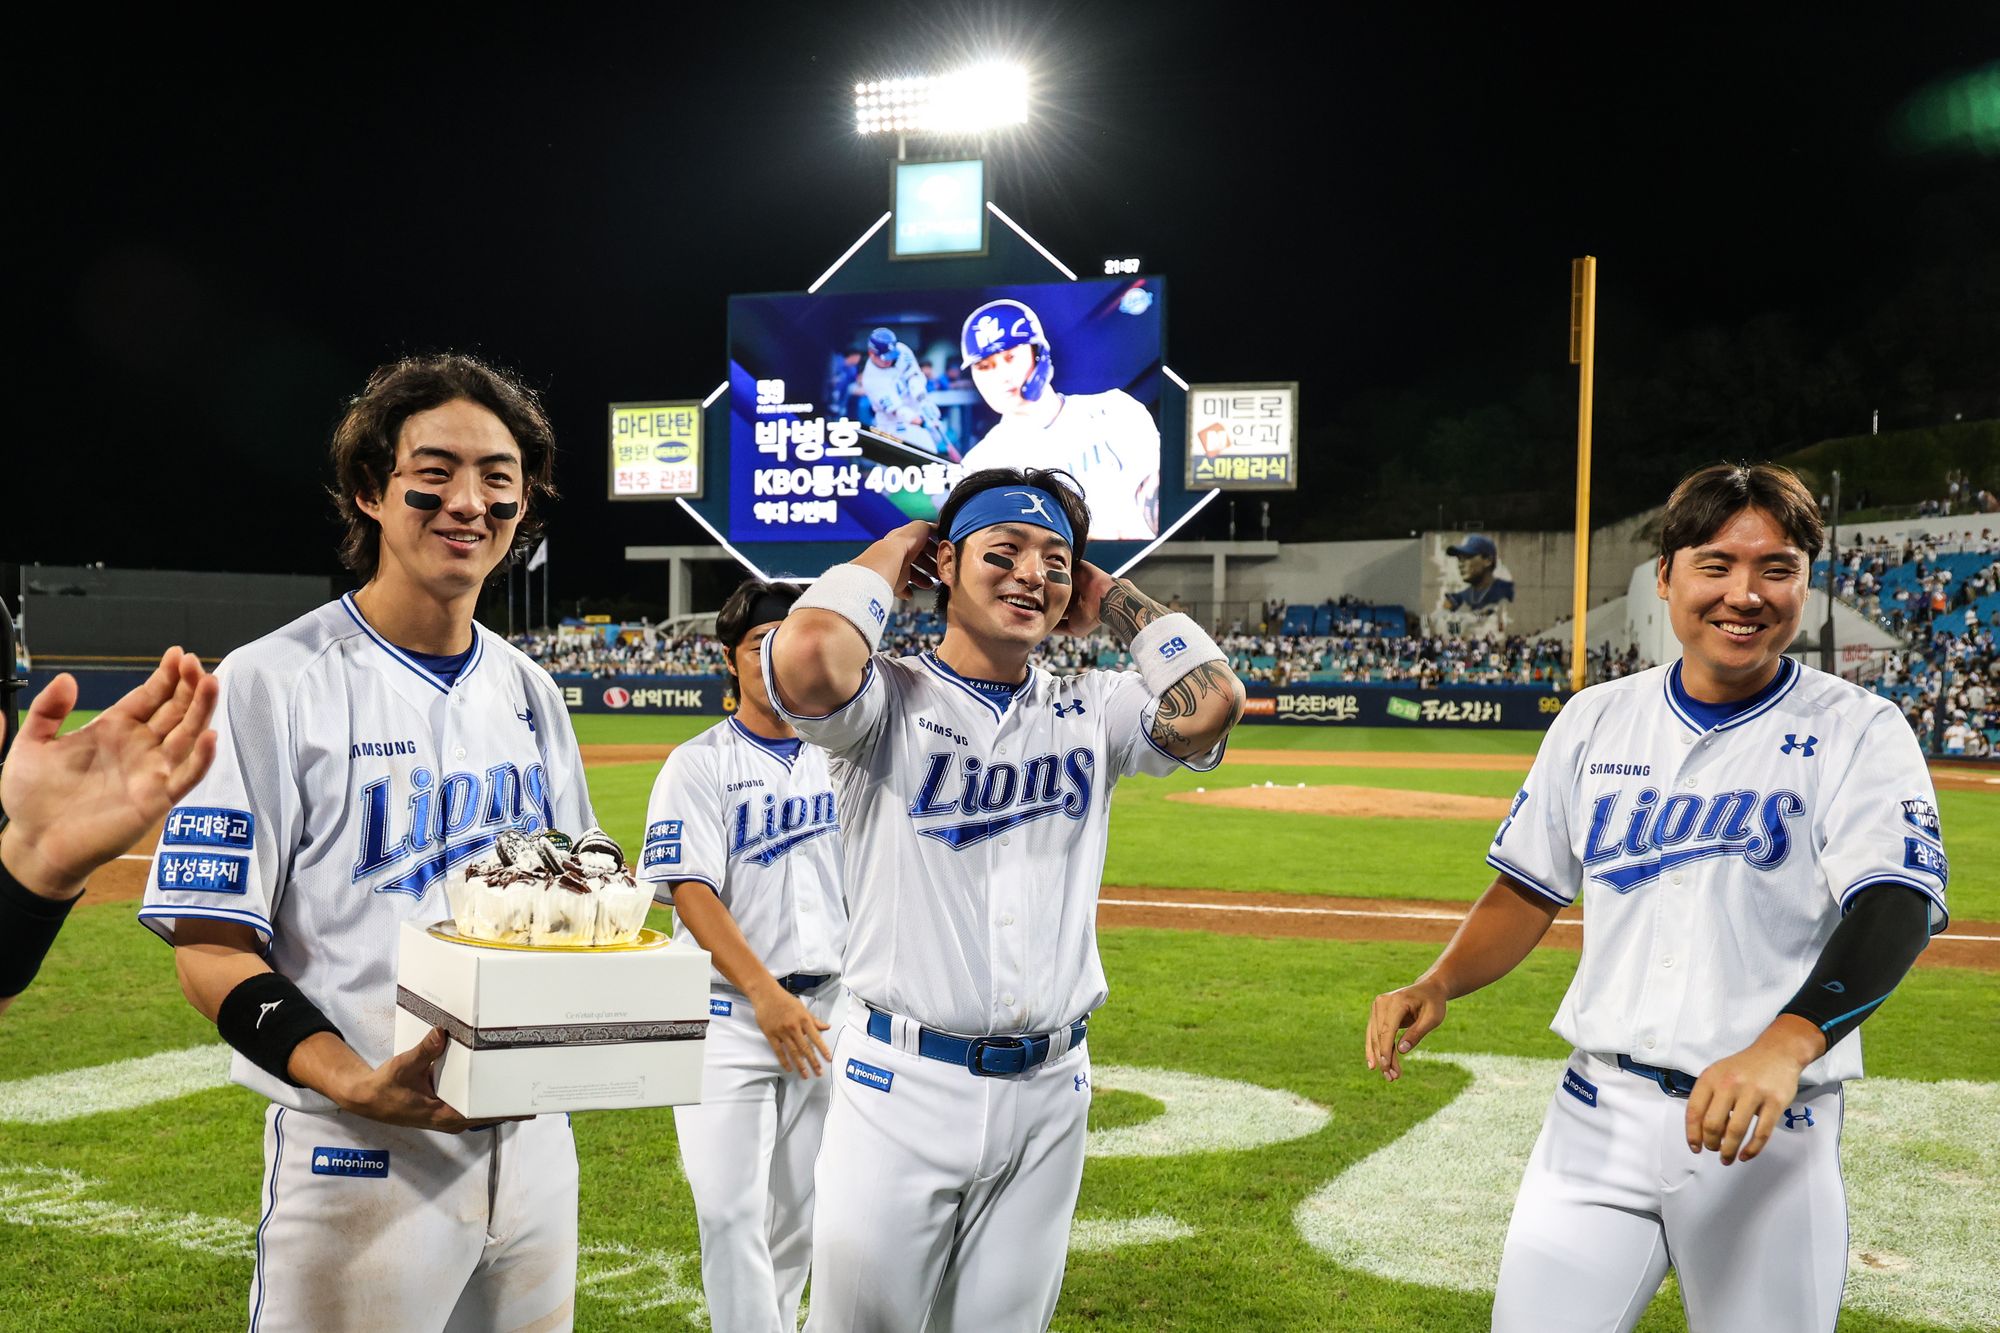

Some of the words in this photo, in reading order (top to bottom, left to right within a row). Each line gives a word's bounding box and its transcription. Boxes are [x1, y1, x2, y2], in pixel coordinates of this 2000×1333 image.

[1203, 396, 1283, 419] 메트로
[619, 412, 693, 438] 마디탄탄
[1233, 424, 1283, 447] 안과
[756, 417, 863, 462] 박병호
[619, 445, 649, 461] 병원
[660, 470, 692, 489] 관절
[754, 464, 861, 496] KBO통산
[1196, 457, 1287, 481] 스마일라식
[1159, 636, 1187, 659] 59
[631, 688, 703, 708] 삼익THK
[1421, 699, 1502, 722] 풍산김치
[349, 740, 417, 760] AMSUNG
[1590, 763, 1650, 777] SAMSUNG
[908, 746, 1095, 820] Lions
[1904, 801, 1928, 814] WIN
[166, 814, 248, 839] 대구대학교
[729, 791, 840, 857] Lion
[1582, 787, 1806, 871] Lions
[163, 858, 240, 884] 삼성화재
[854, 1067, 889, 1085] monimo
[1569, 1081, 1594, 1100] monimo
[331, 1157, 385, 1170] monimo
